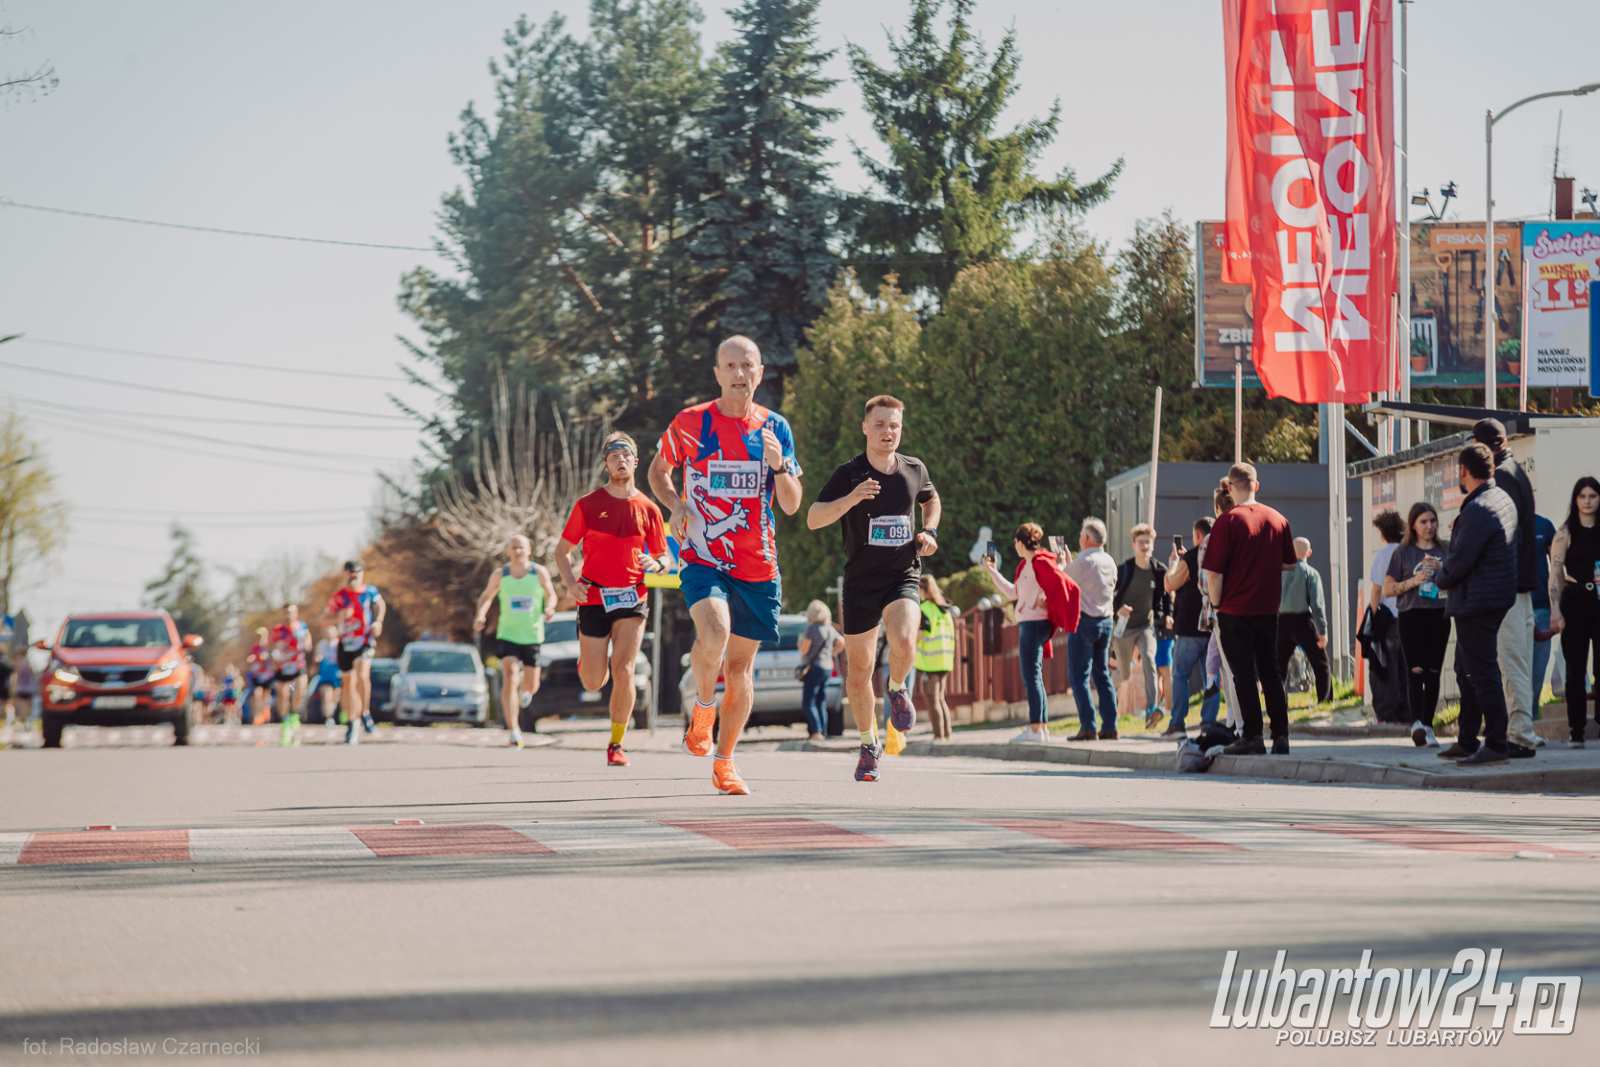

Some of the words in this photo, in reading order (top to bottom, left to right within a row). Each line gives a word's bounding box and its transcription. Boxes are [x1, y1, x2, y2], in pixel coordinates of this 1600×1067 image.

[1435, 234, 1509, 245] FISKAS
[731, 473, 757, 488] 013
[889, 526, 909, 538] 093
